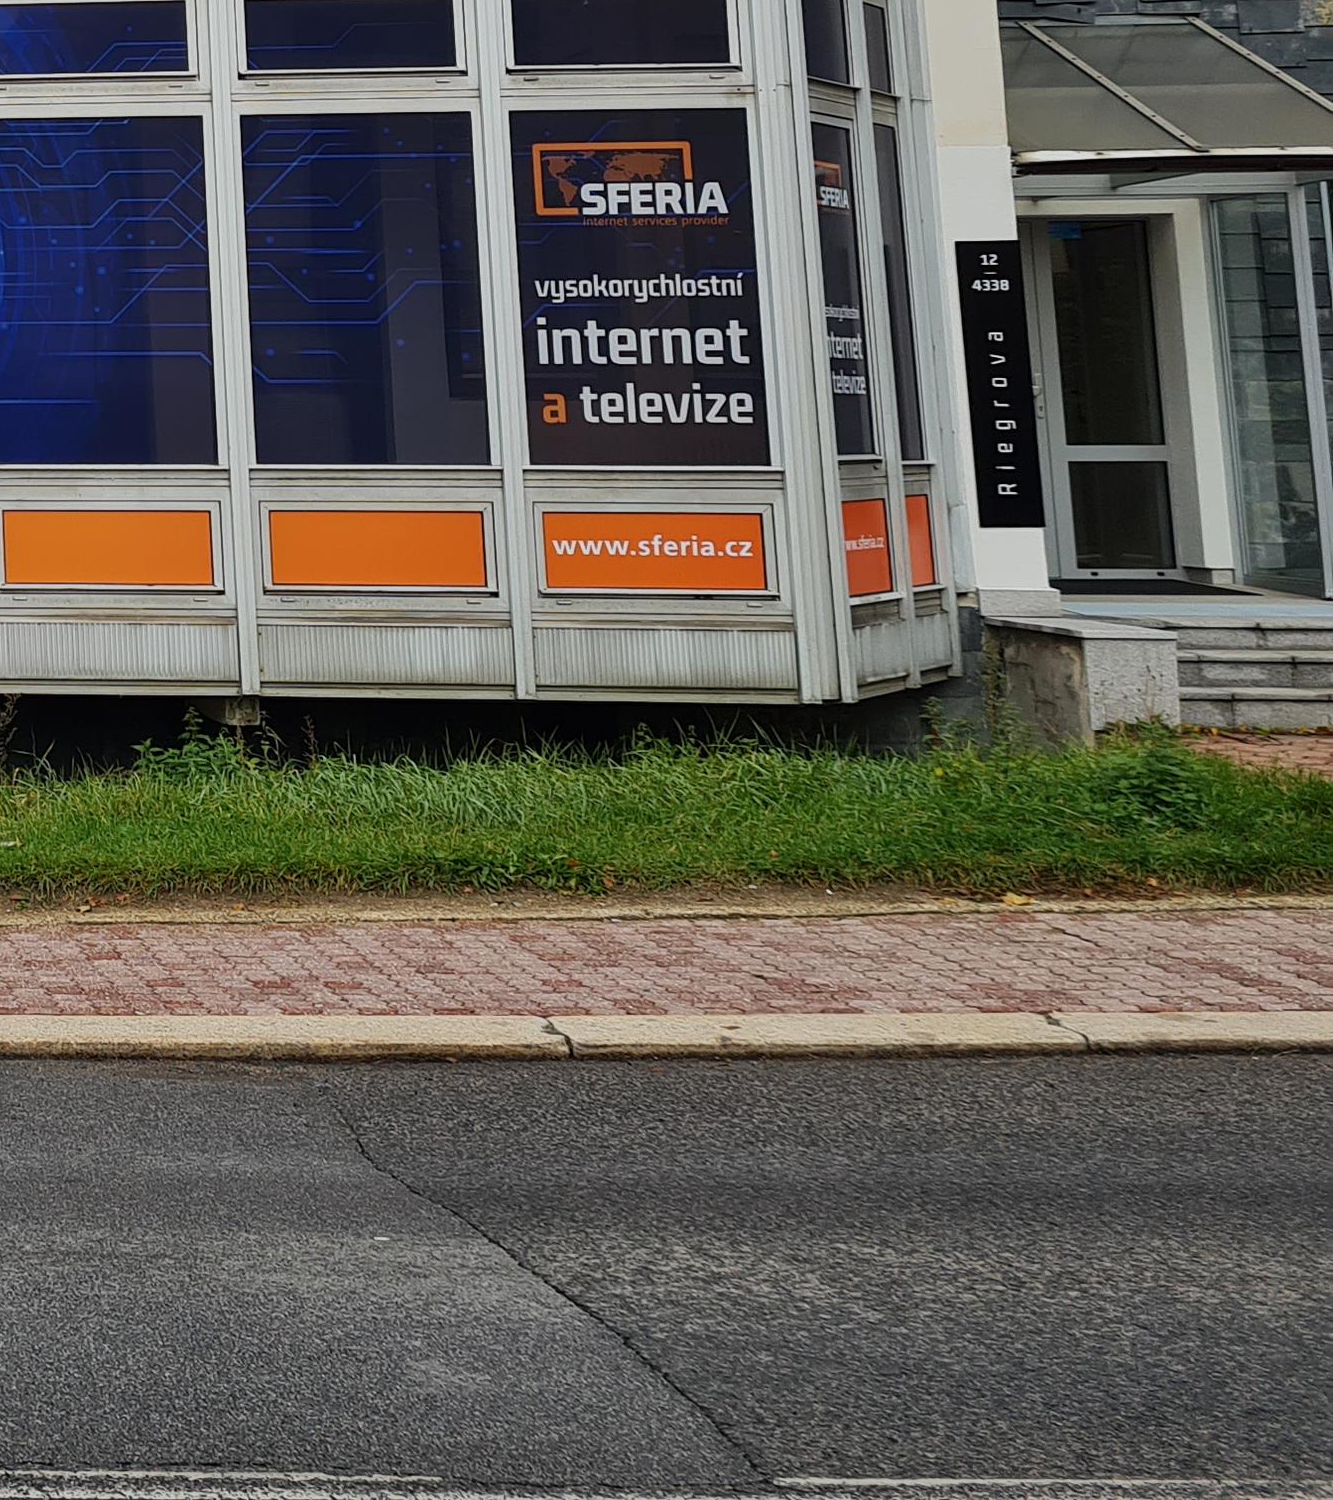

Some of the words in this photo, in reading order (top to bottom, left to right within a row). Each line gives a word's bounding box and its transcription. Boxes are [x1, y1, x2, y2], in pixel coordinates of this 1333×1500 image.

[580, 181, 730, 215] SFERIA
[582, 217, 629, 227] internet
[632, 216, 678, 226] services
[682, 215, 730, 227] provider
[979, 253, 999, 266] 12
[534, 272, 744, 304] vysokorychlostní
[970, 278, 1010, 292] 4338
[536, 316, 751, 365] internet
[541, 392, 567, 424] a
[579, 382, 754, 424] televize
[987, 330, 1019, 496] Riegrova
[551, 534, 754, 557] www.sferia.cz
